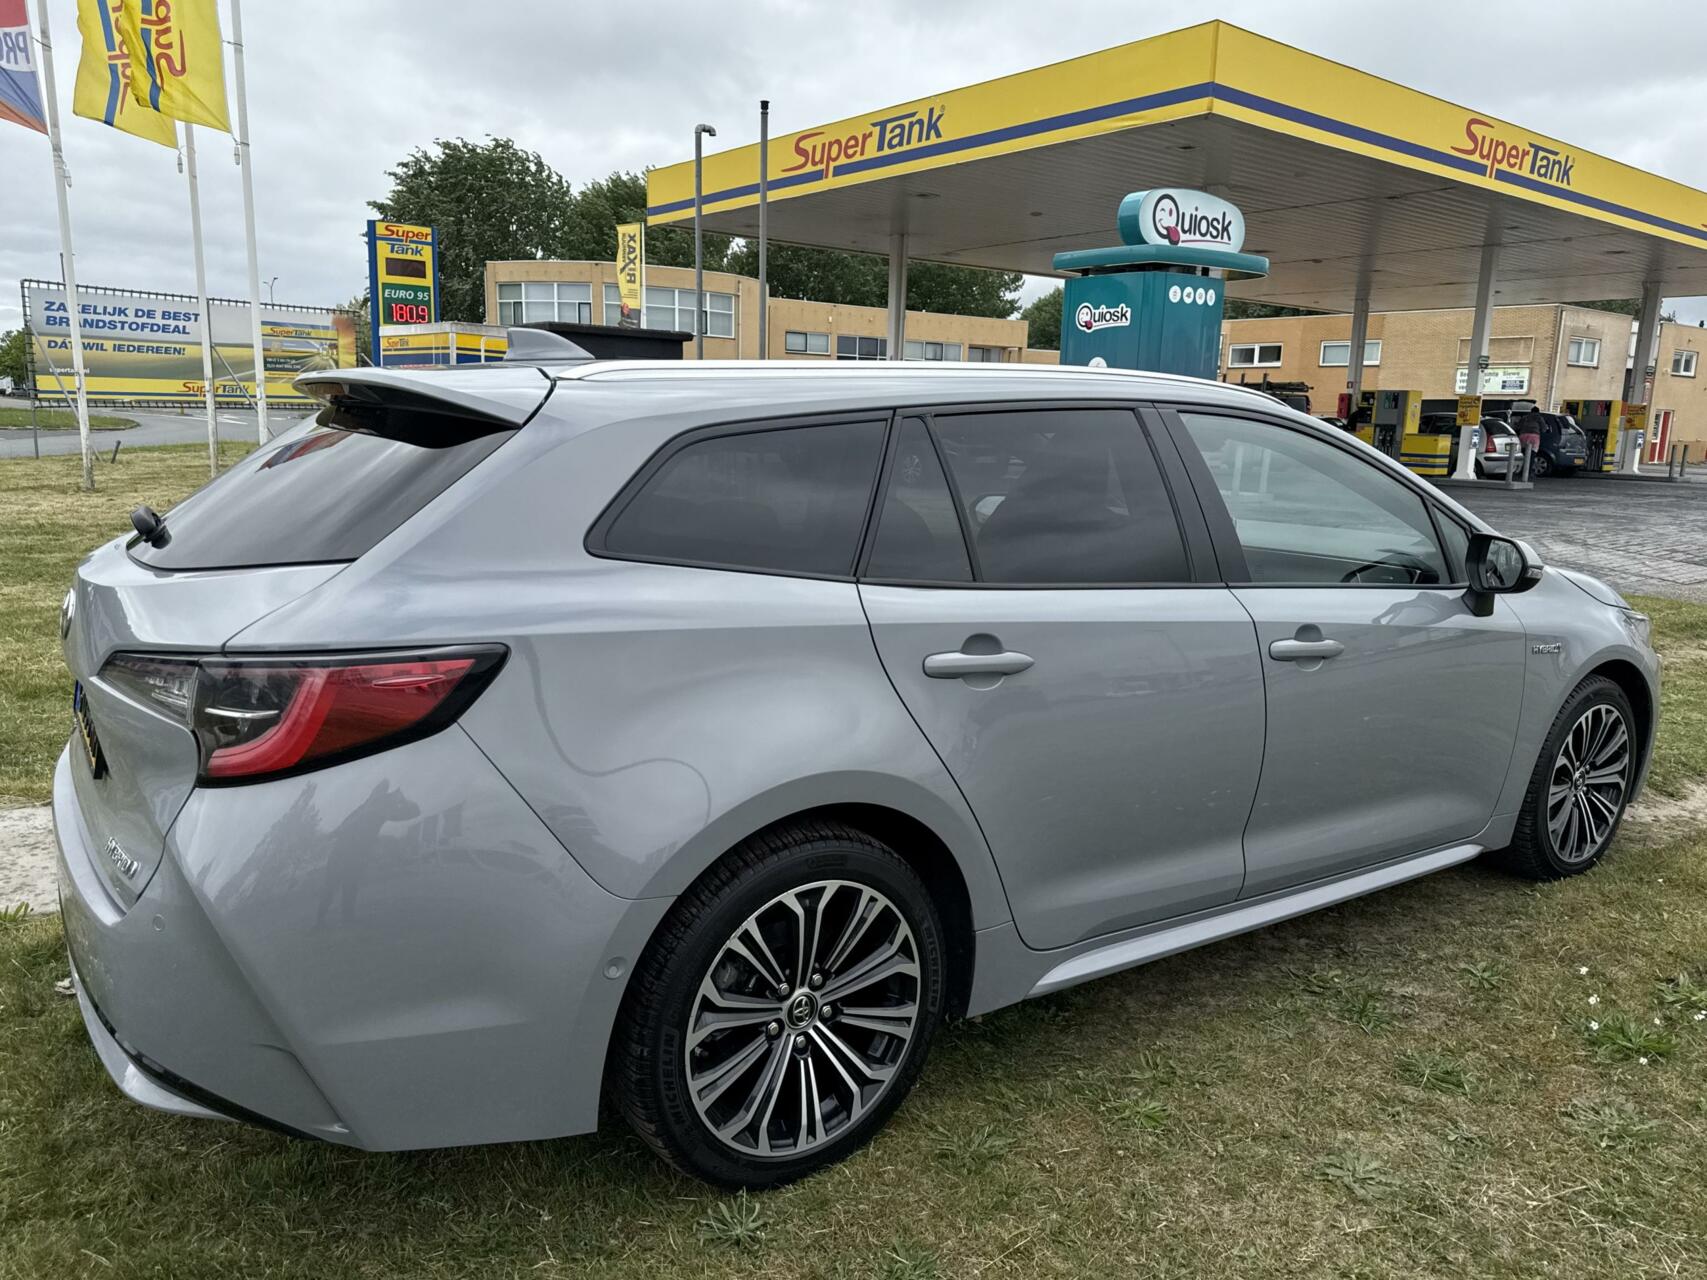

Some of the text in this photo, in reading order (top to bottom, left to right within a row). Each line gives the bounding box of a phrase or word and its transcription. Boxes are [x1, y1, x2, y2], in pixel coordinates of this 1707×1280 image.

[1153, 193, 1232, 246] Quiosk
[378, 224, 431, 243] Super
[386, 242, 424, 257] Tank
[384, 288, 430, 301] EURO 95
[44, 301, 200, 323] ZAELIJK DE BEST
[391, 303, 429, 323] 180.9
[1078, 305, 1129, 330] Quiosk
[82, 340, 108, 352] WIL
[113, 343, 186, 356] IEDEREEN!
[177, 381, 250, 398] SuprTank
